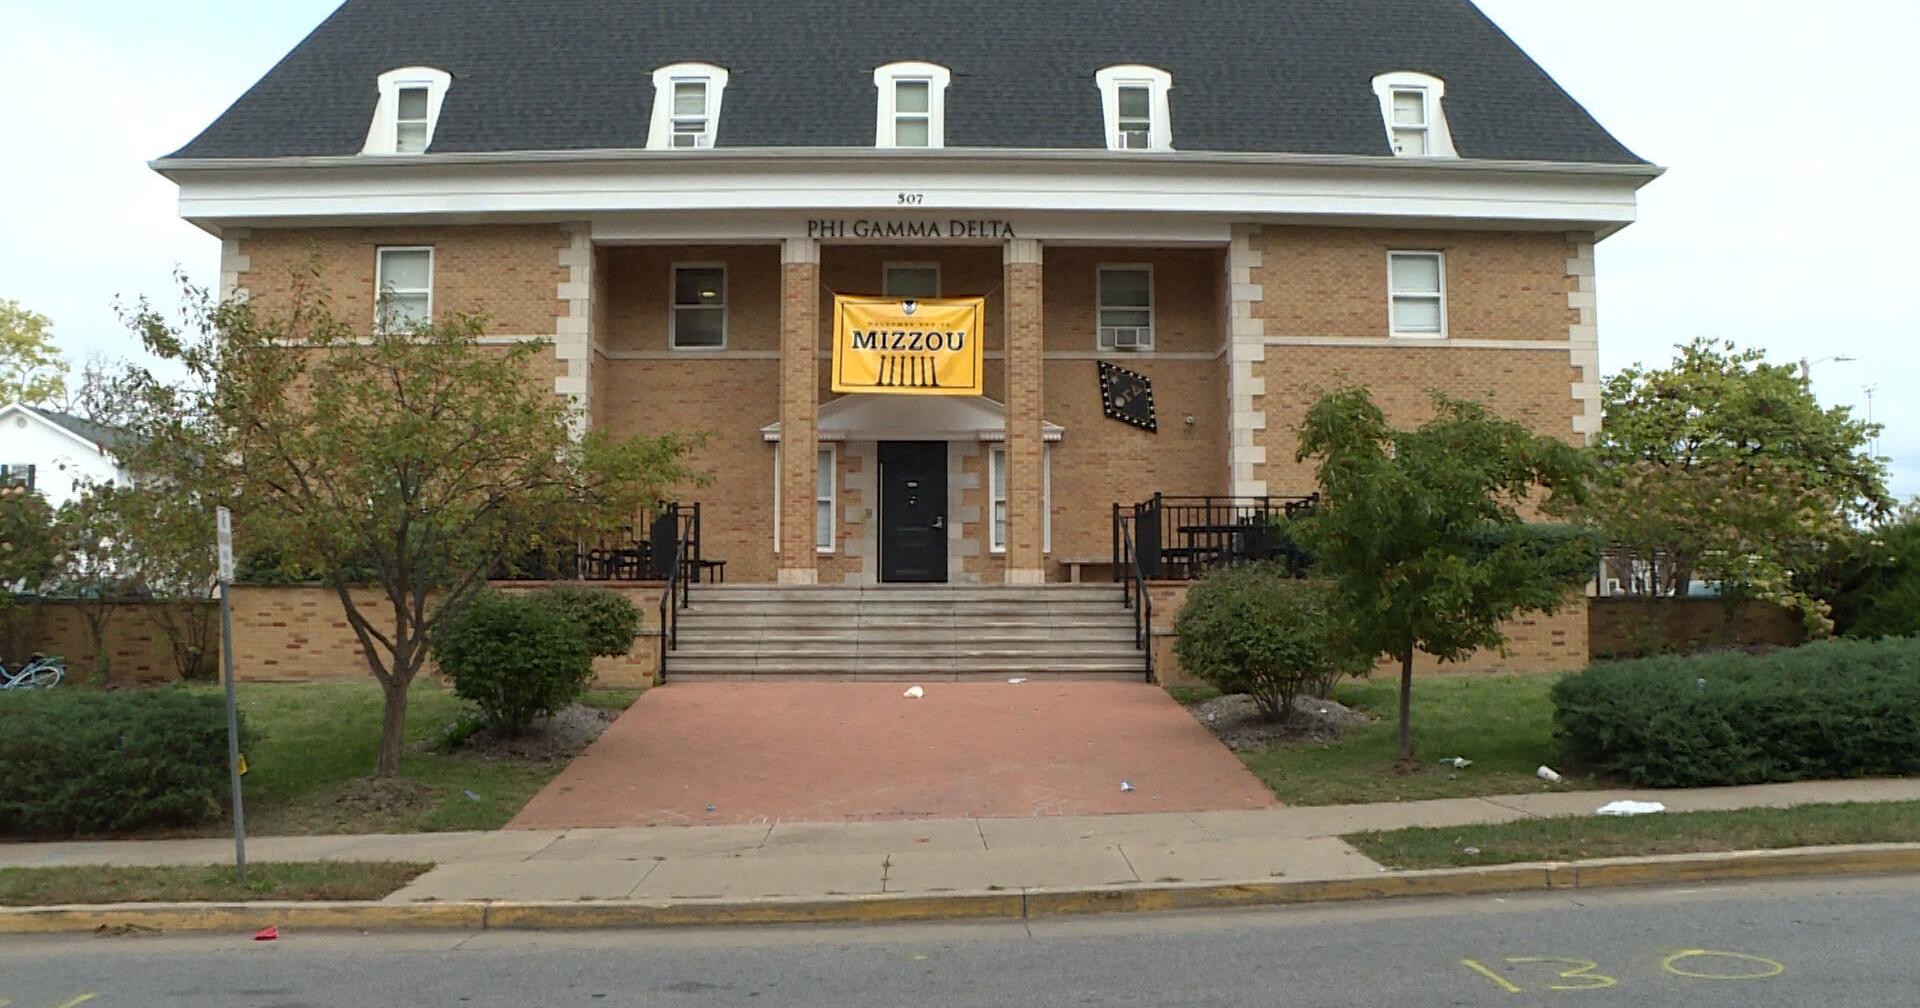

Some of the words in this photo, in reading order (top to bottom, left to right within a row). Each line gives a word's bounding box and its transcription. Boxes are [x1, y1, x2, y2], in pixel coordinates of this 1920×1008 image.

[897, 194, 924, 205] 507
[807, 219, 844, 237] PHI
[853, 219, 940, 237] GAMMA
[949, 219, 1015, 237] DELTA
[852, 330, 966, 351] MIZZOU
